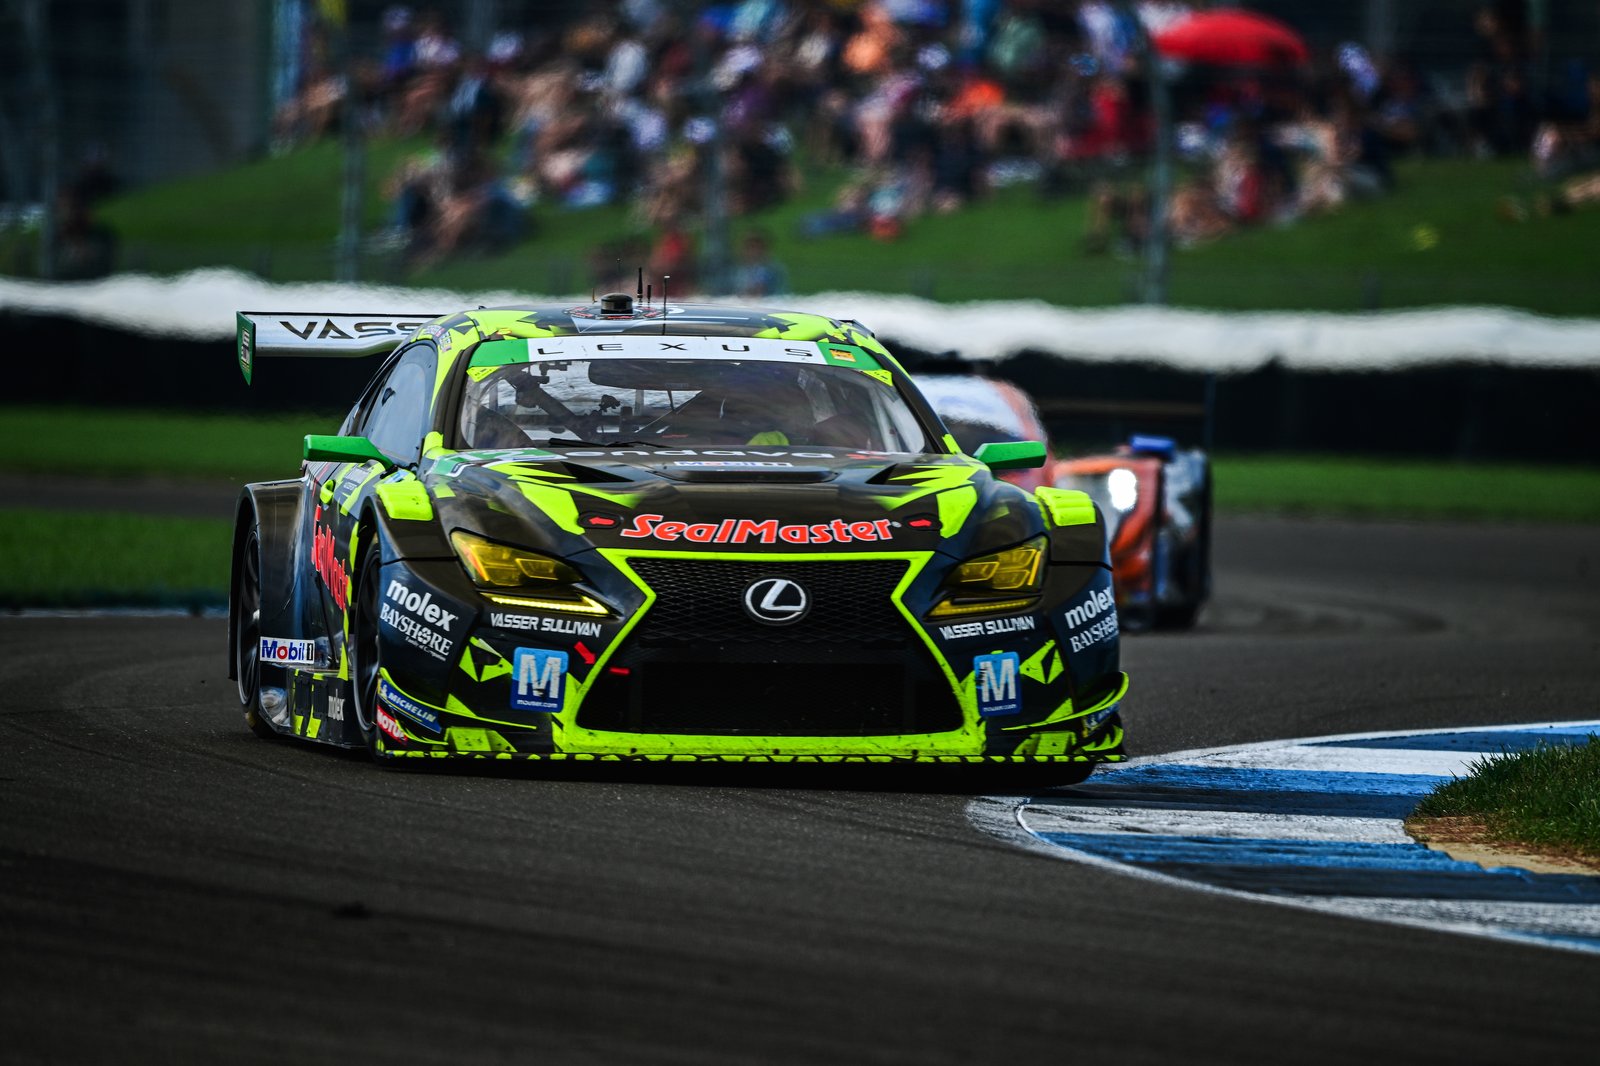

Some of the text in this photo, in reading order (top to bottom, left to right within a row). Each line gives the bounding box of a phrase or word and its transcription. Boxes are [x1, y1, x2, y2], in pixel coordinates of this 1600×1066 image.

[620, 514, 895, 543] SealMaster
[386, 580, 456, 631] molex
[380, 603, 453, 655] BAYSHORE
[491, 613, 602, 638] VASSER SULLIVAN
[939, 616, 1035, 640] VASSER SULLIVAN
[261, 639, 305, 660] Mobil
[518, 654, 562, 698] M
[979, 658, 1017, 702] M
[388, 692, 436, 722] MICHELIN
[517, 699, 558, 708] mouser.com
